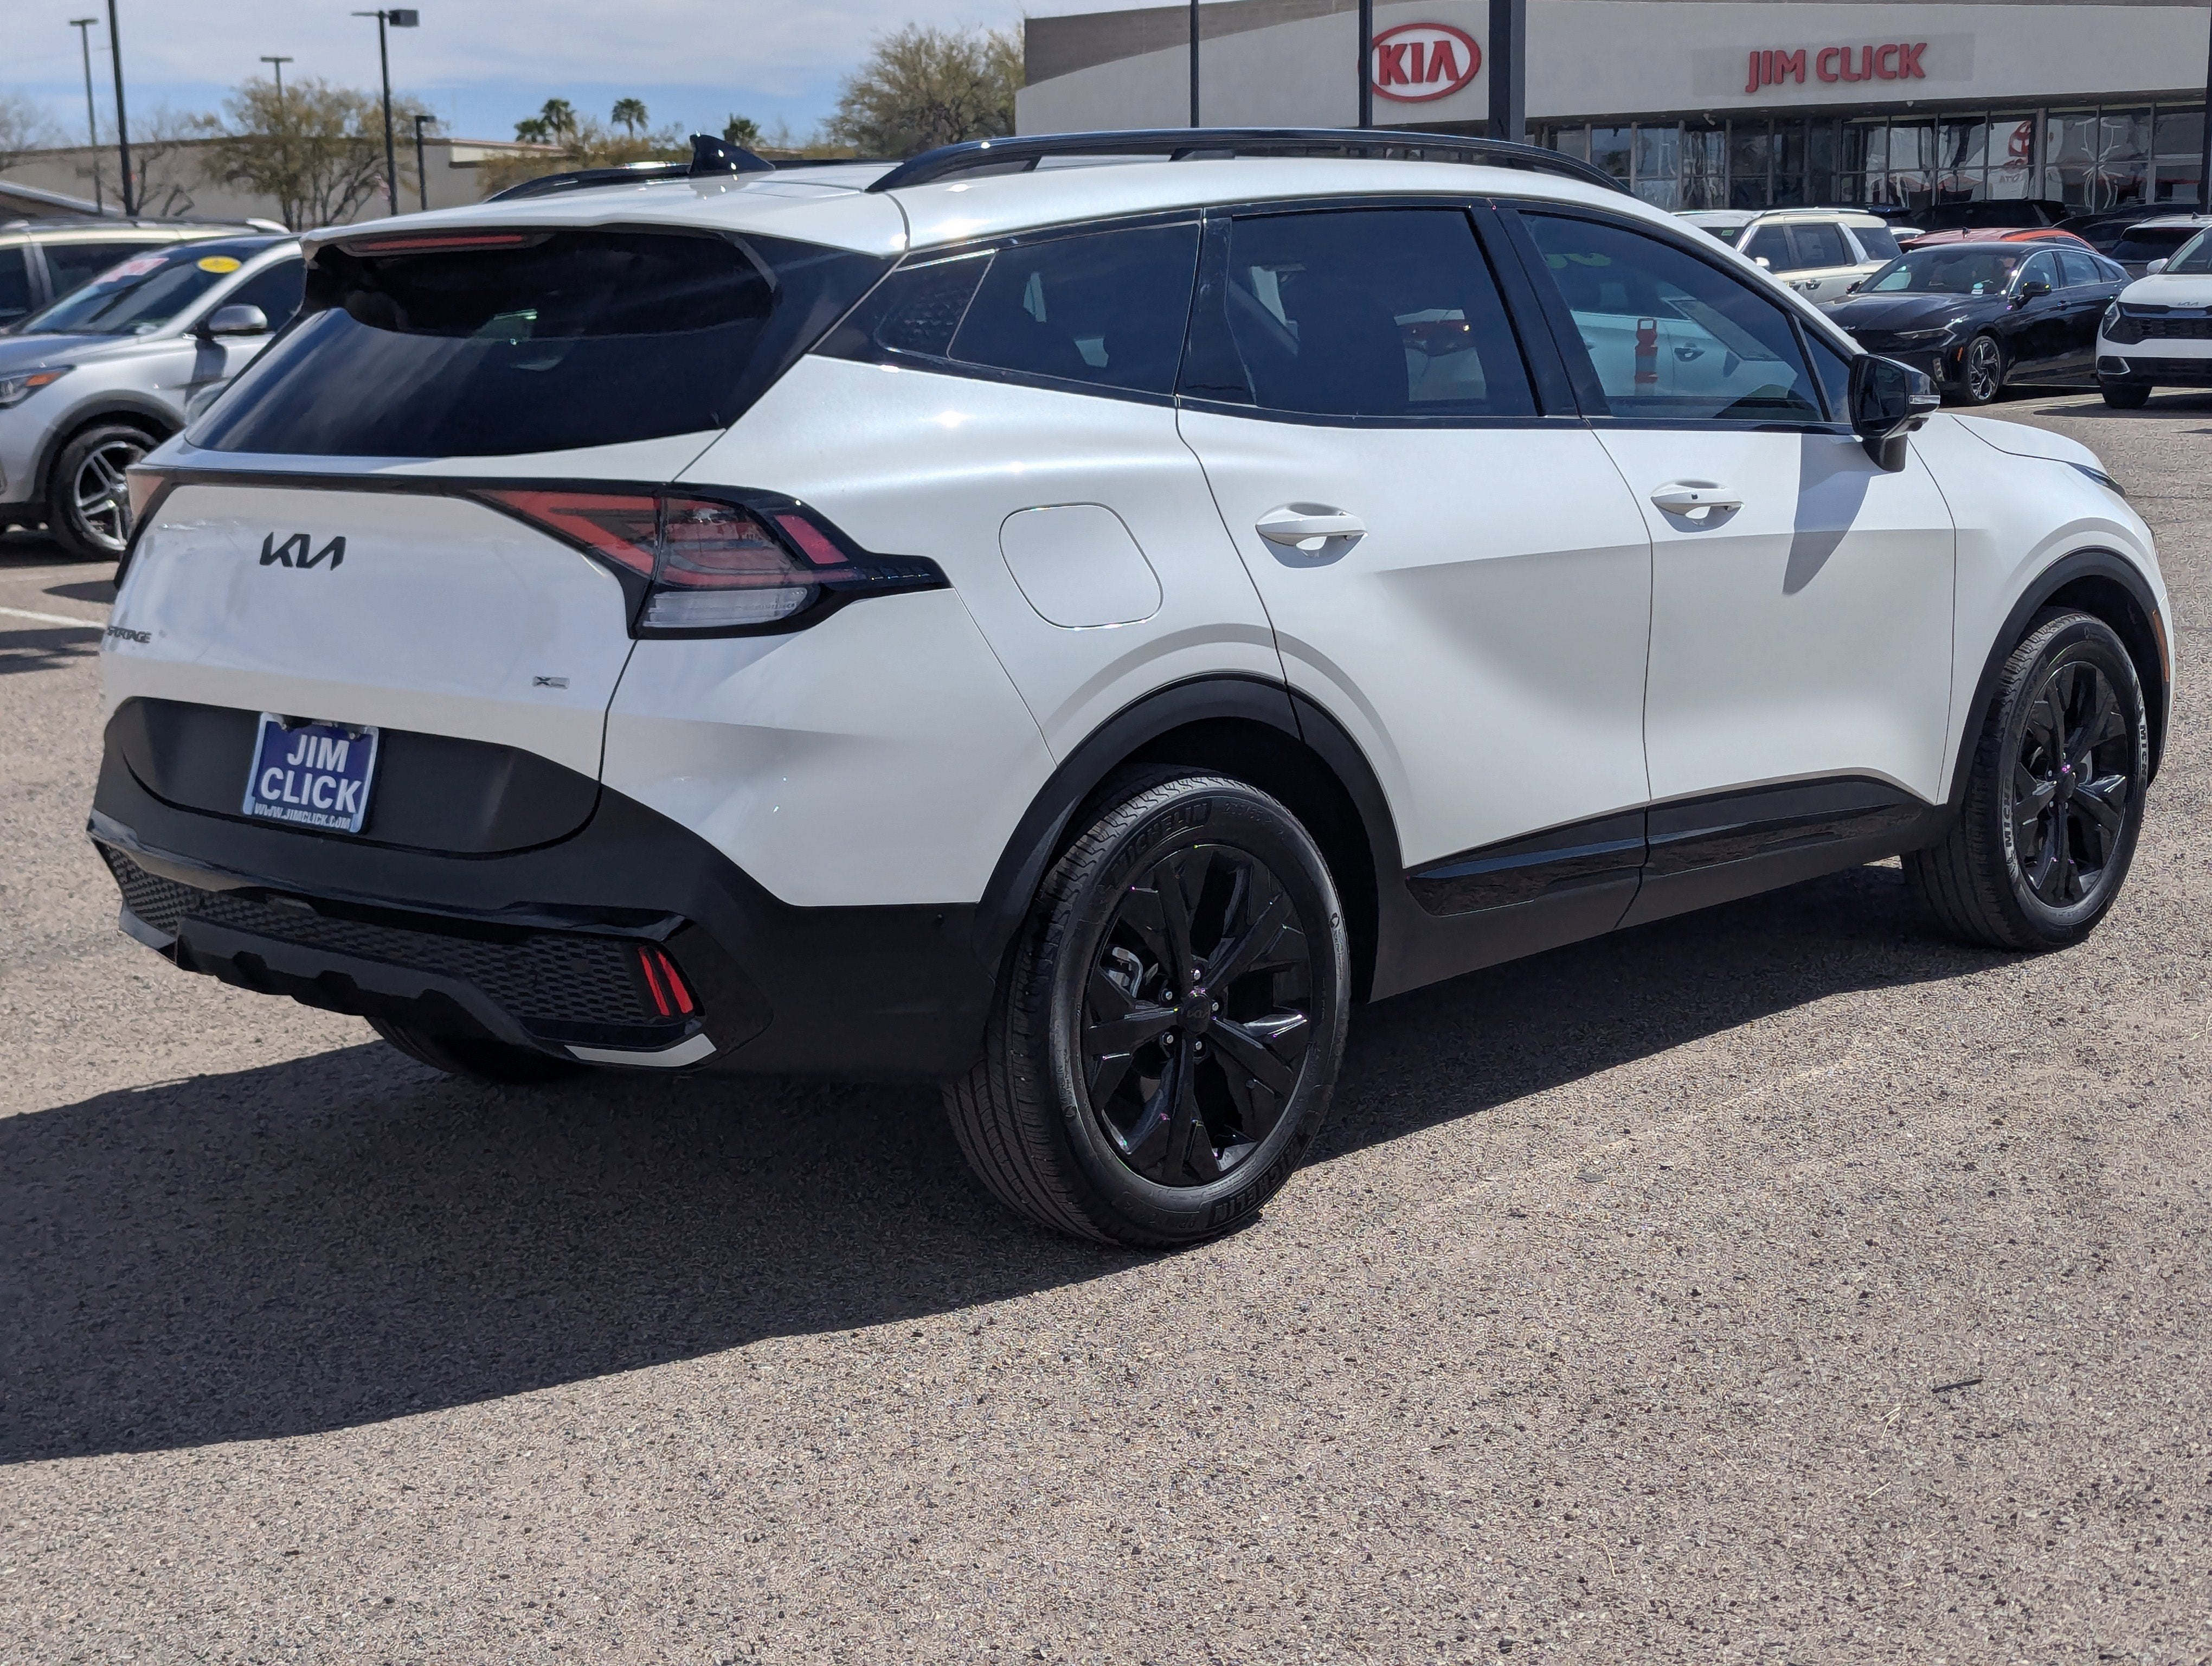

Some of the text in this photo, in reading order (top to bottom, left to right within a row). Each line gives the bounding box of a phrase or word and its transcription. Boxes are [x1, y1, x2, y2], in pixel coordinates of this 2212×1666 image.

[1378, 40, 1459, 85] KIA
[1745, 43, 1927, 93] JIM CLICK
[259, 531, 346, 571] KIA
[287, 734, 350, 773] JIM
[260, 767, 362, 813] CLICK
[254, 802, 351, 830] WWW.JIMCLICK.COM
